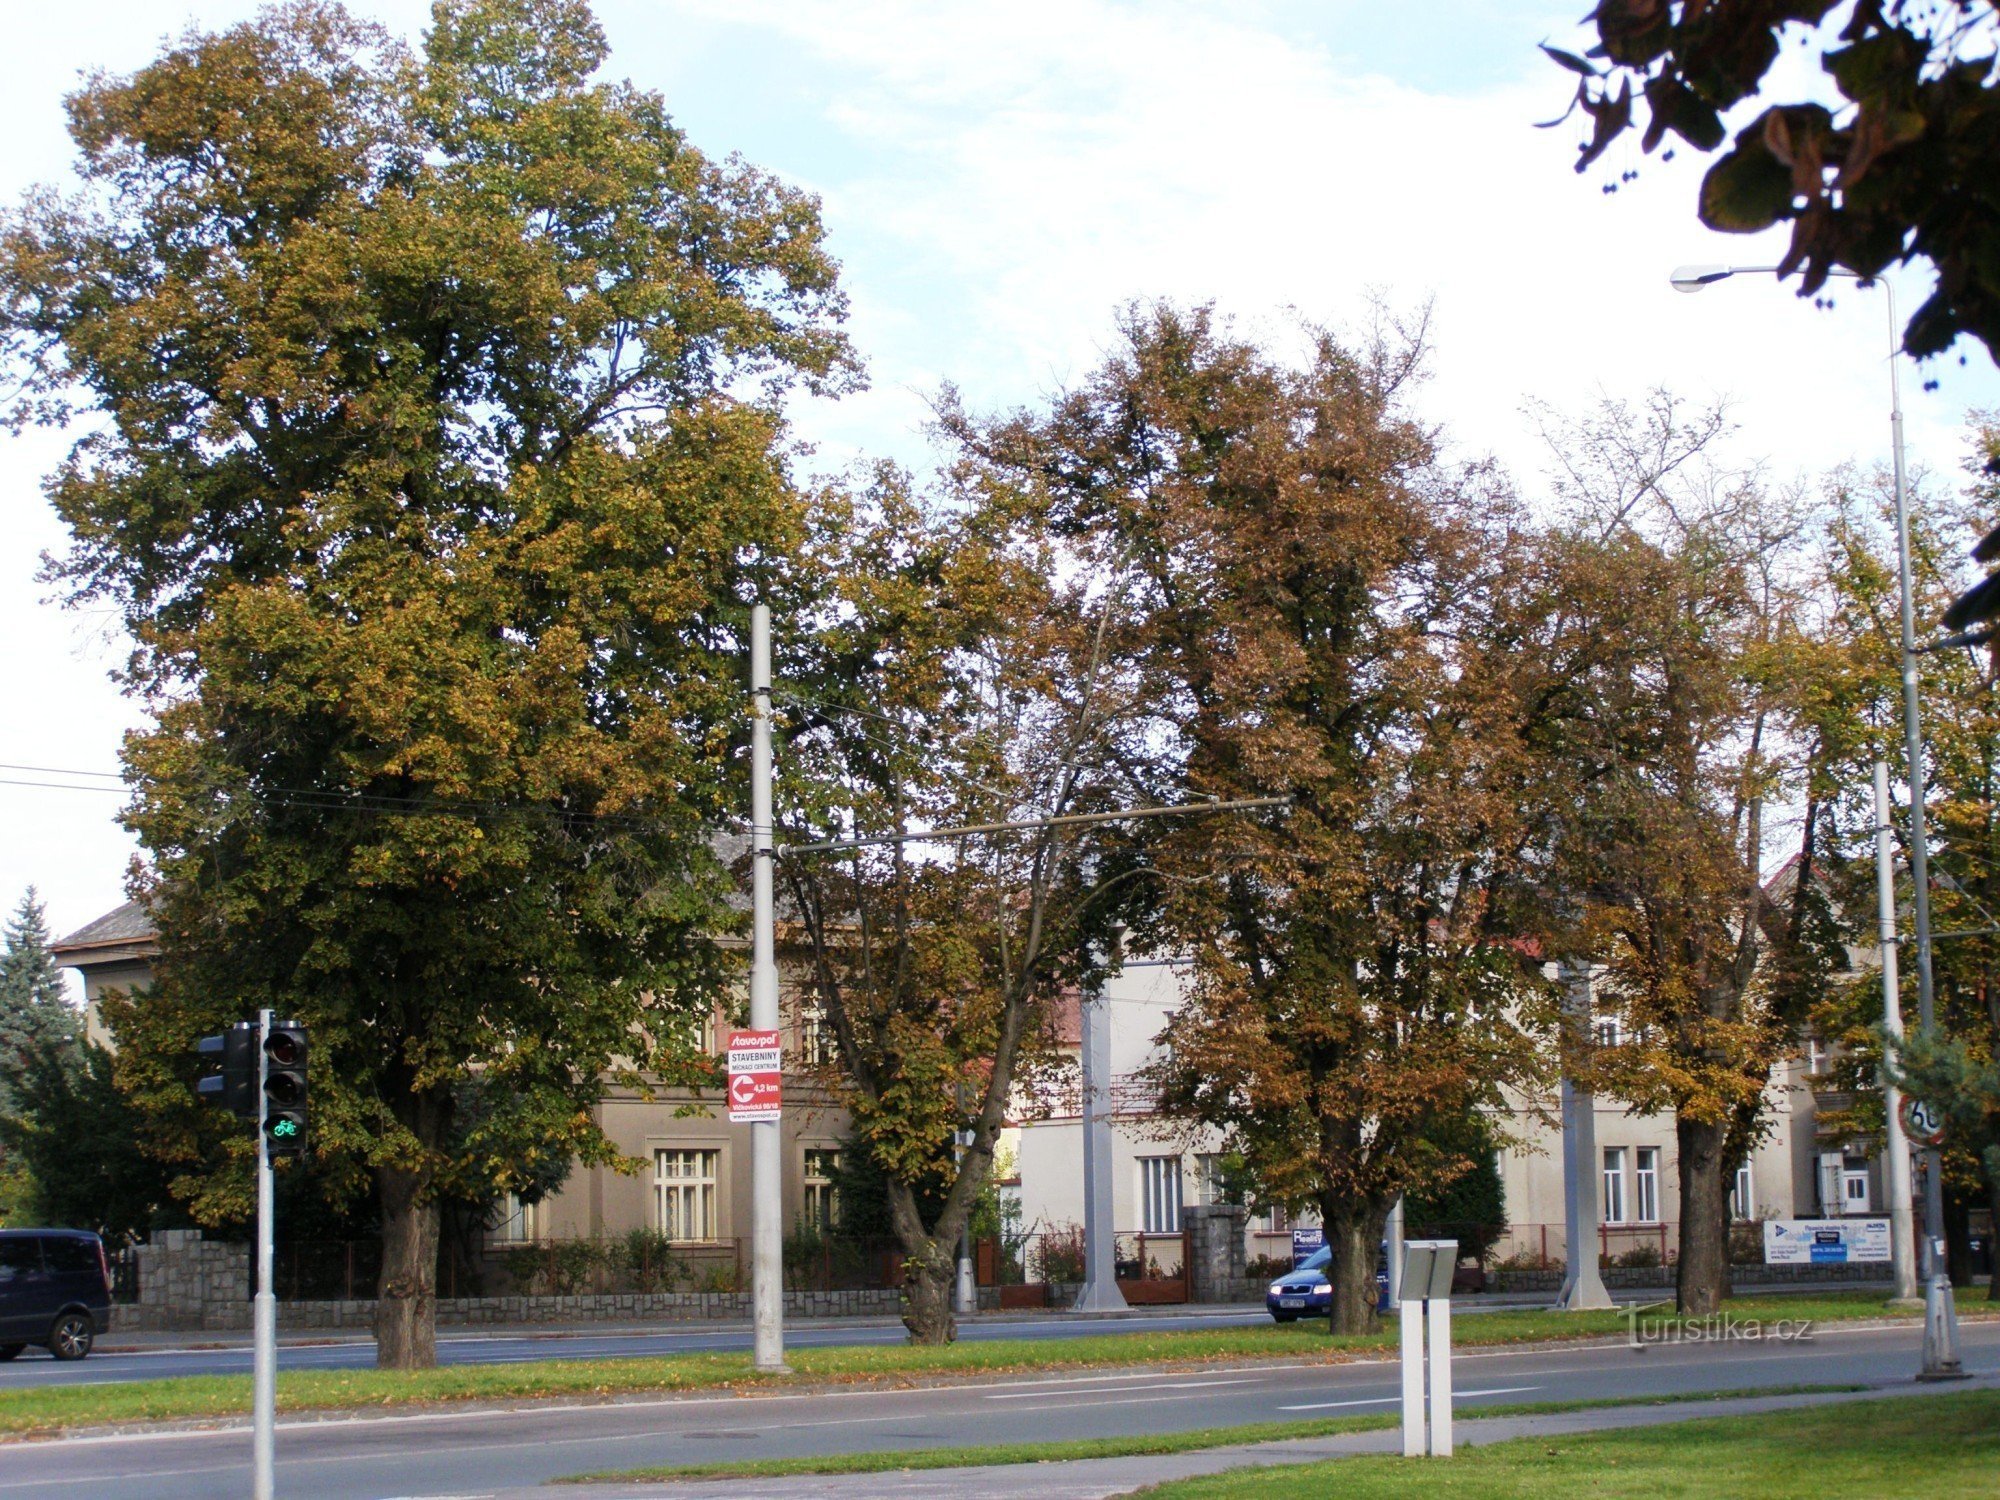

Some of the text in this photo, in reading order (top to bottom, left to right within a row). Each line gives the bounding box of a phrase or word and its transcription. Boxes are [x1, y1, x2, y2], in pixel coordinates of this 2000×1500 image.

[732, 1052, 777, 1061] STAVEBNINY
[753, 1084, 778, 1093] 4,2 km
